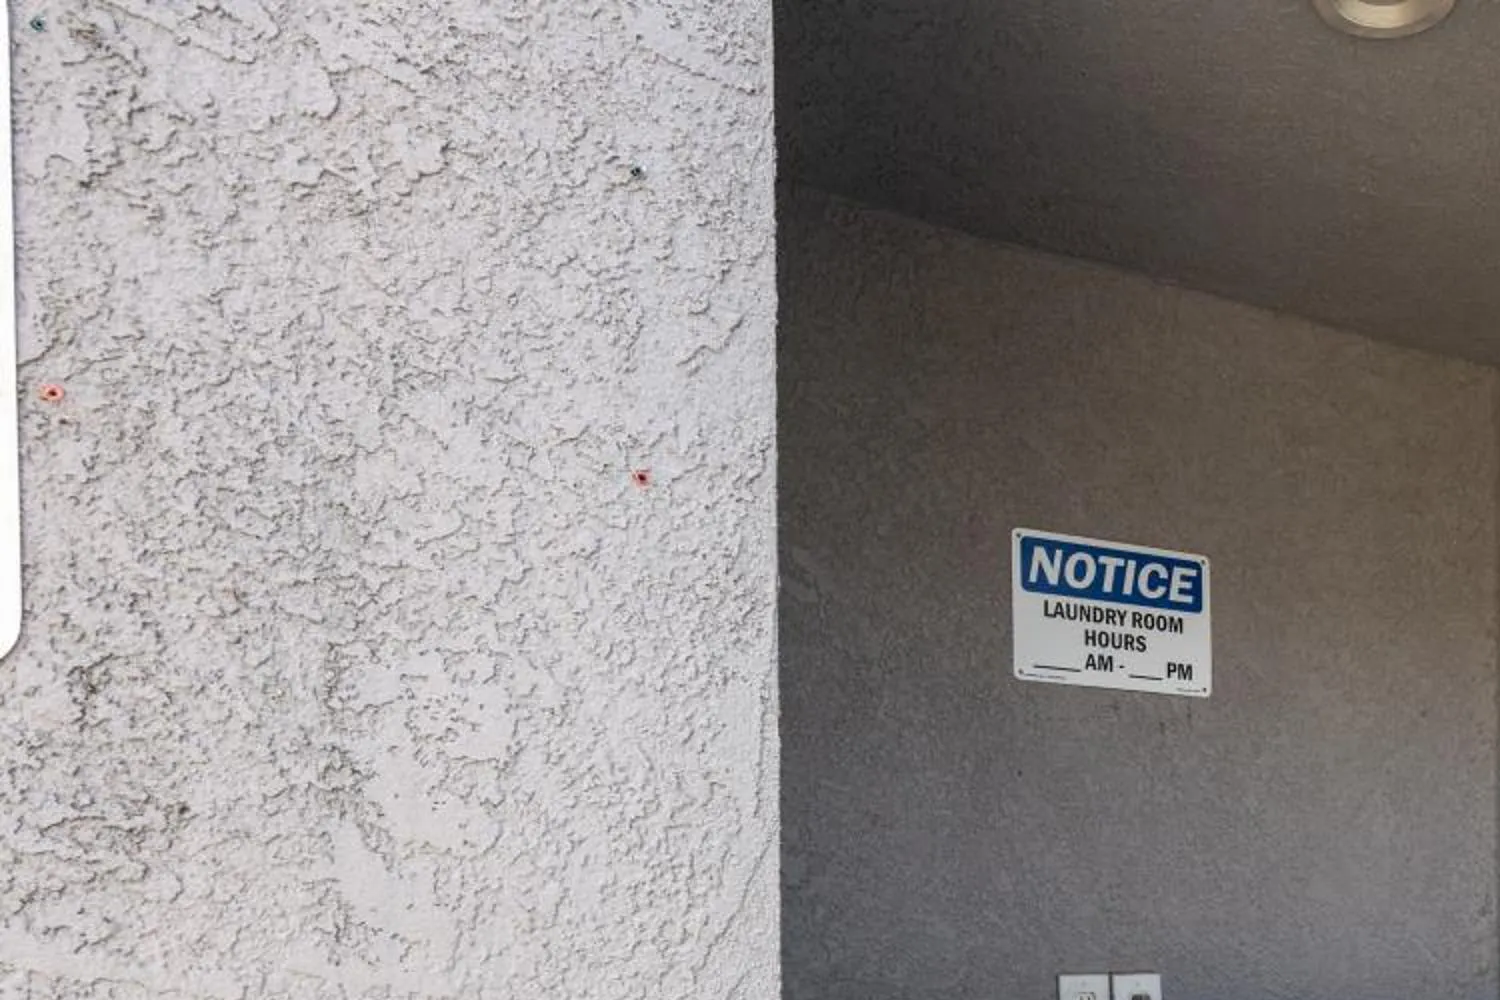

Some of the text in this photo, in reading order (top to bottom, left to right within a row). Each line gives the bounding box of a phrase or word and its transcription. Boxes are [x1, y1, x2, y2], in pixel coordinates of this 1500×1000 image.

[1028, 545, 1197, 604] NOTICE
[1043, 599, 1184, 635] LAUNDRY ROOM
[1084, 629, 1147, 653] HOURS
[1085, 653, 1114, 673] AM
[1167, 661, 1193, 681] PM
